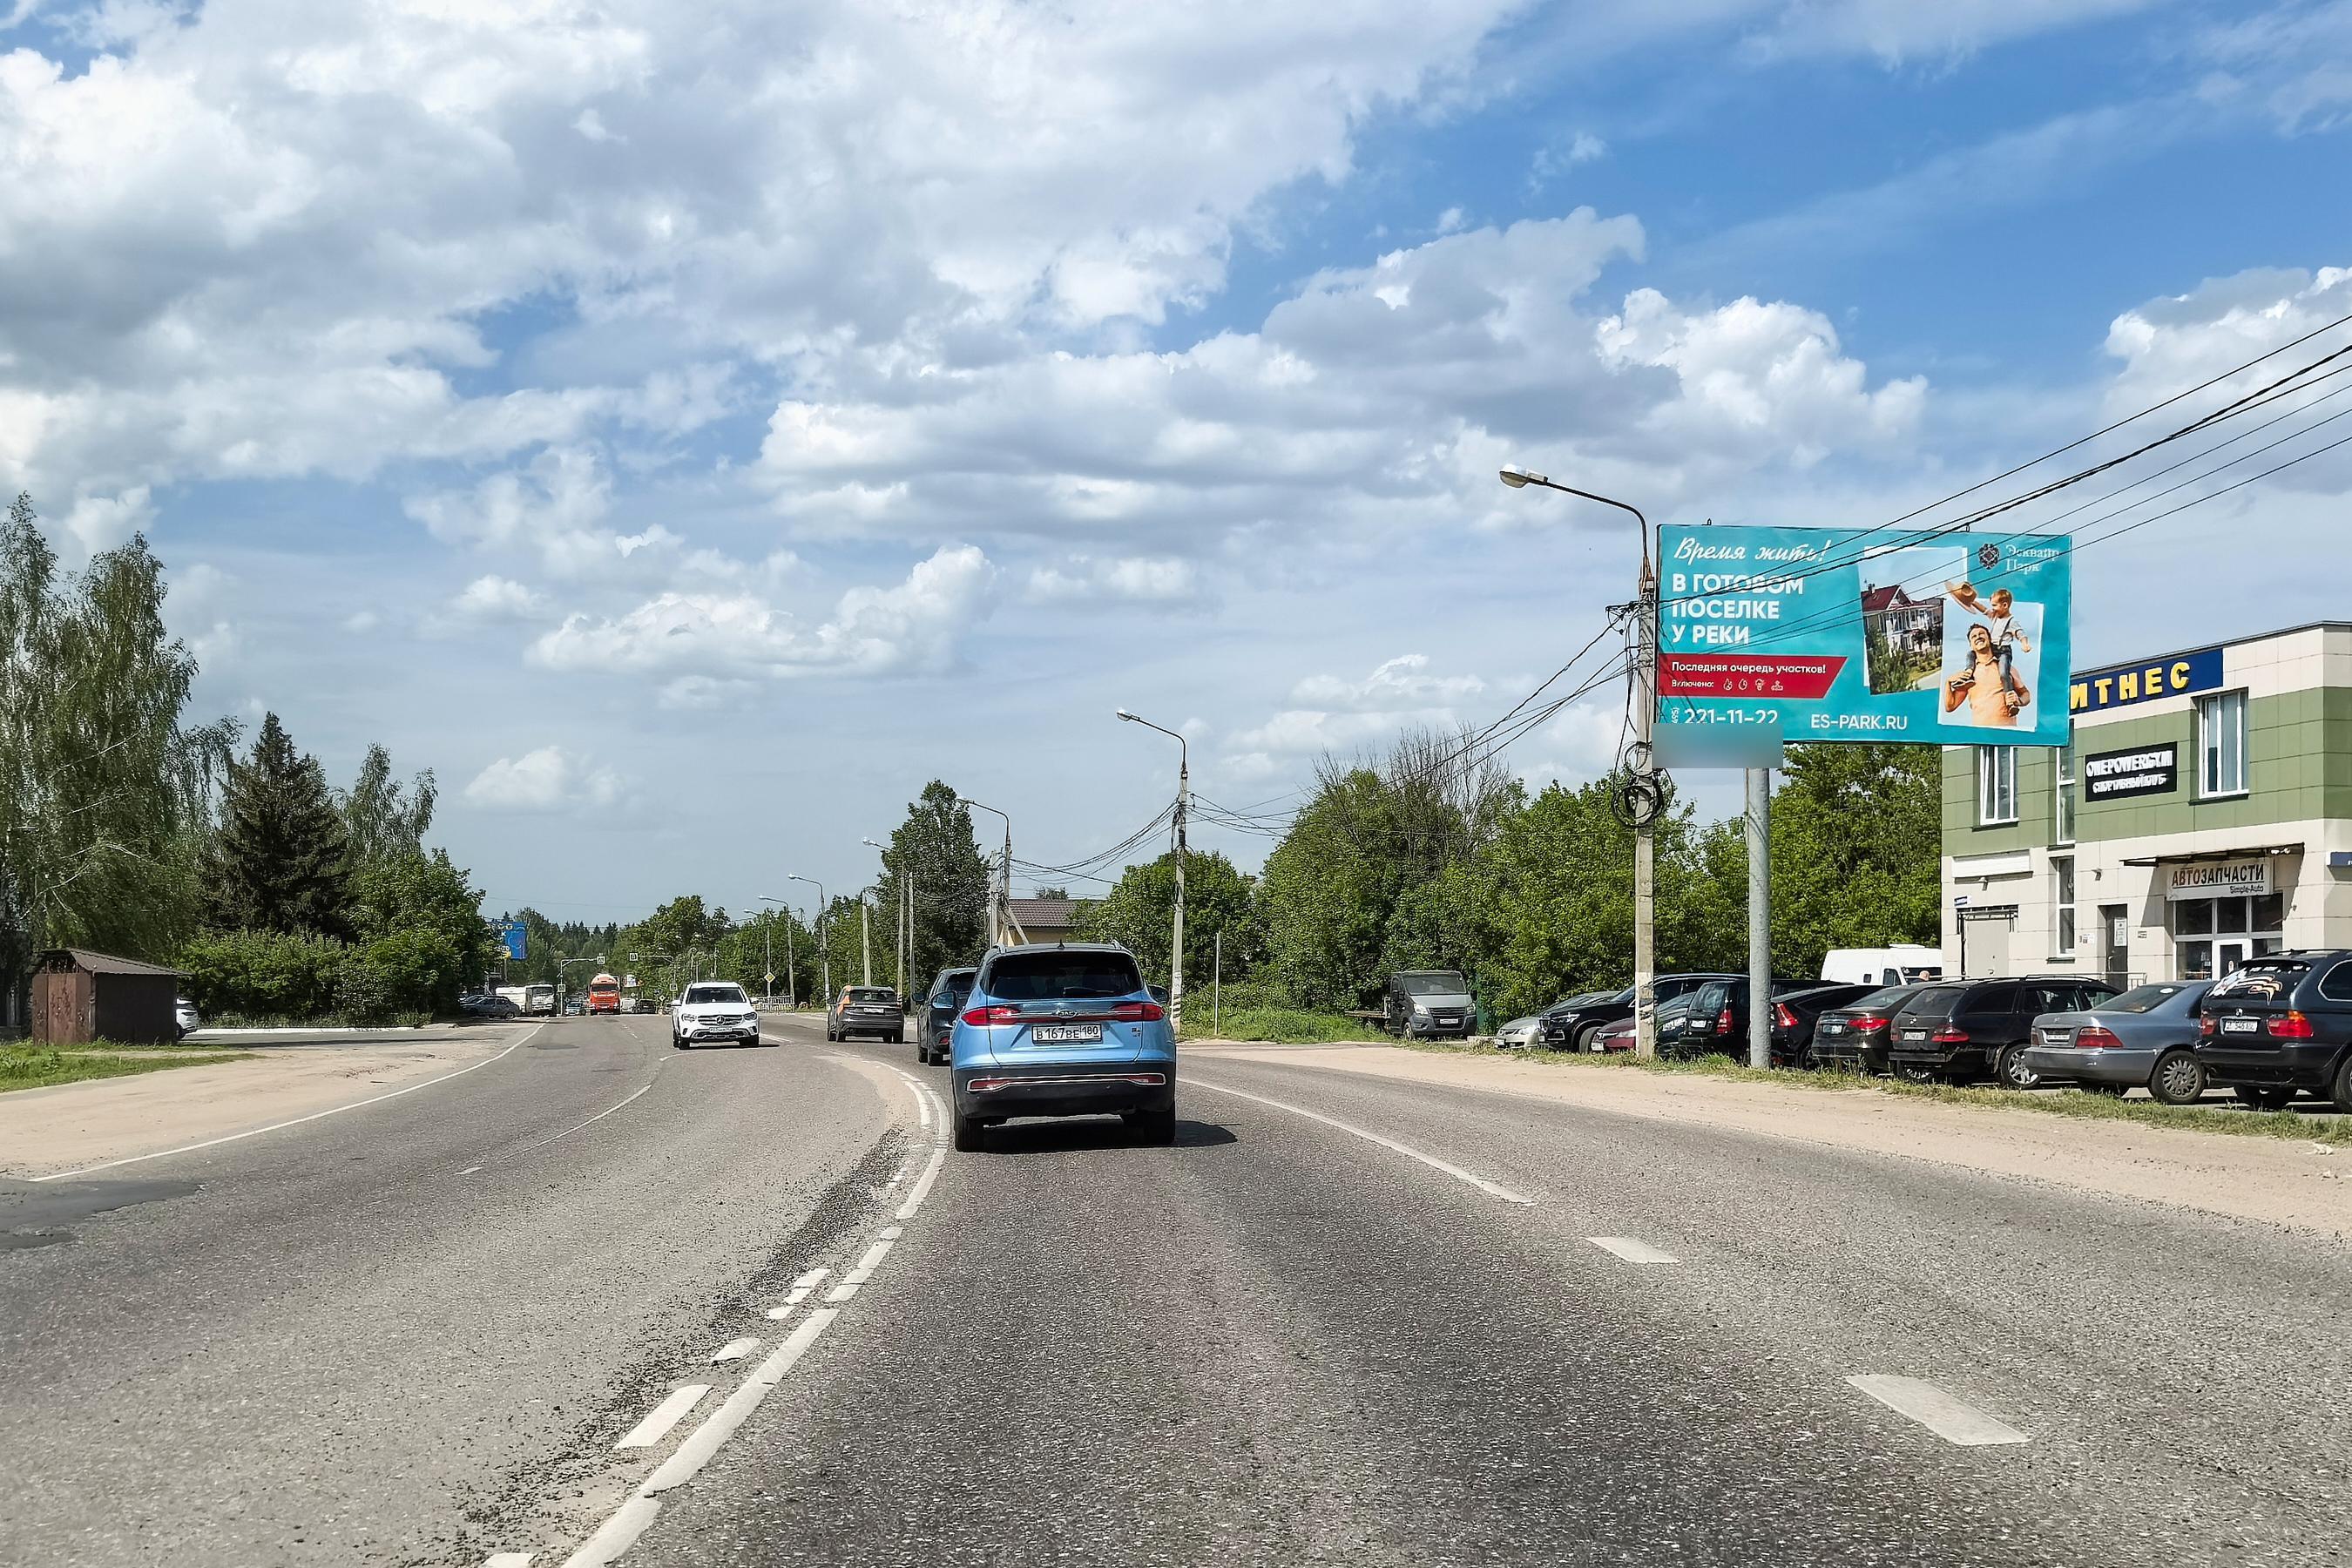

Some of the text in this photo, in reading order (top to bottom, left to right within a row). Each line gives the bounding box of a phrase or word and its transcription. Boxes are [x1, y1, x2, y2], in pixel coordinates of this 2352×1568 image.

[1673, 537, 1831, 564] Время жить!
[1672, 573, 1804, 594] В ГОТОВОМ
[1671, 599, 1780, 619] ПОСЕЛКЕ
[1671, 625, 1750, 645] У РЕКИ
[1672, 661, 1827, 675] Последняя очередь участков!
[1672, 679, 1714, 687] Включено:
[2070, 661, 2191, 710] ИТНЕС
[1811, 713, 1908, 730] ES-PARK.RU
[2171, 863, 2265, 887] АВТОЗАПЧАСТИ
